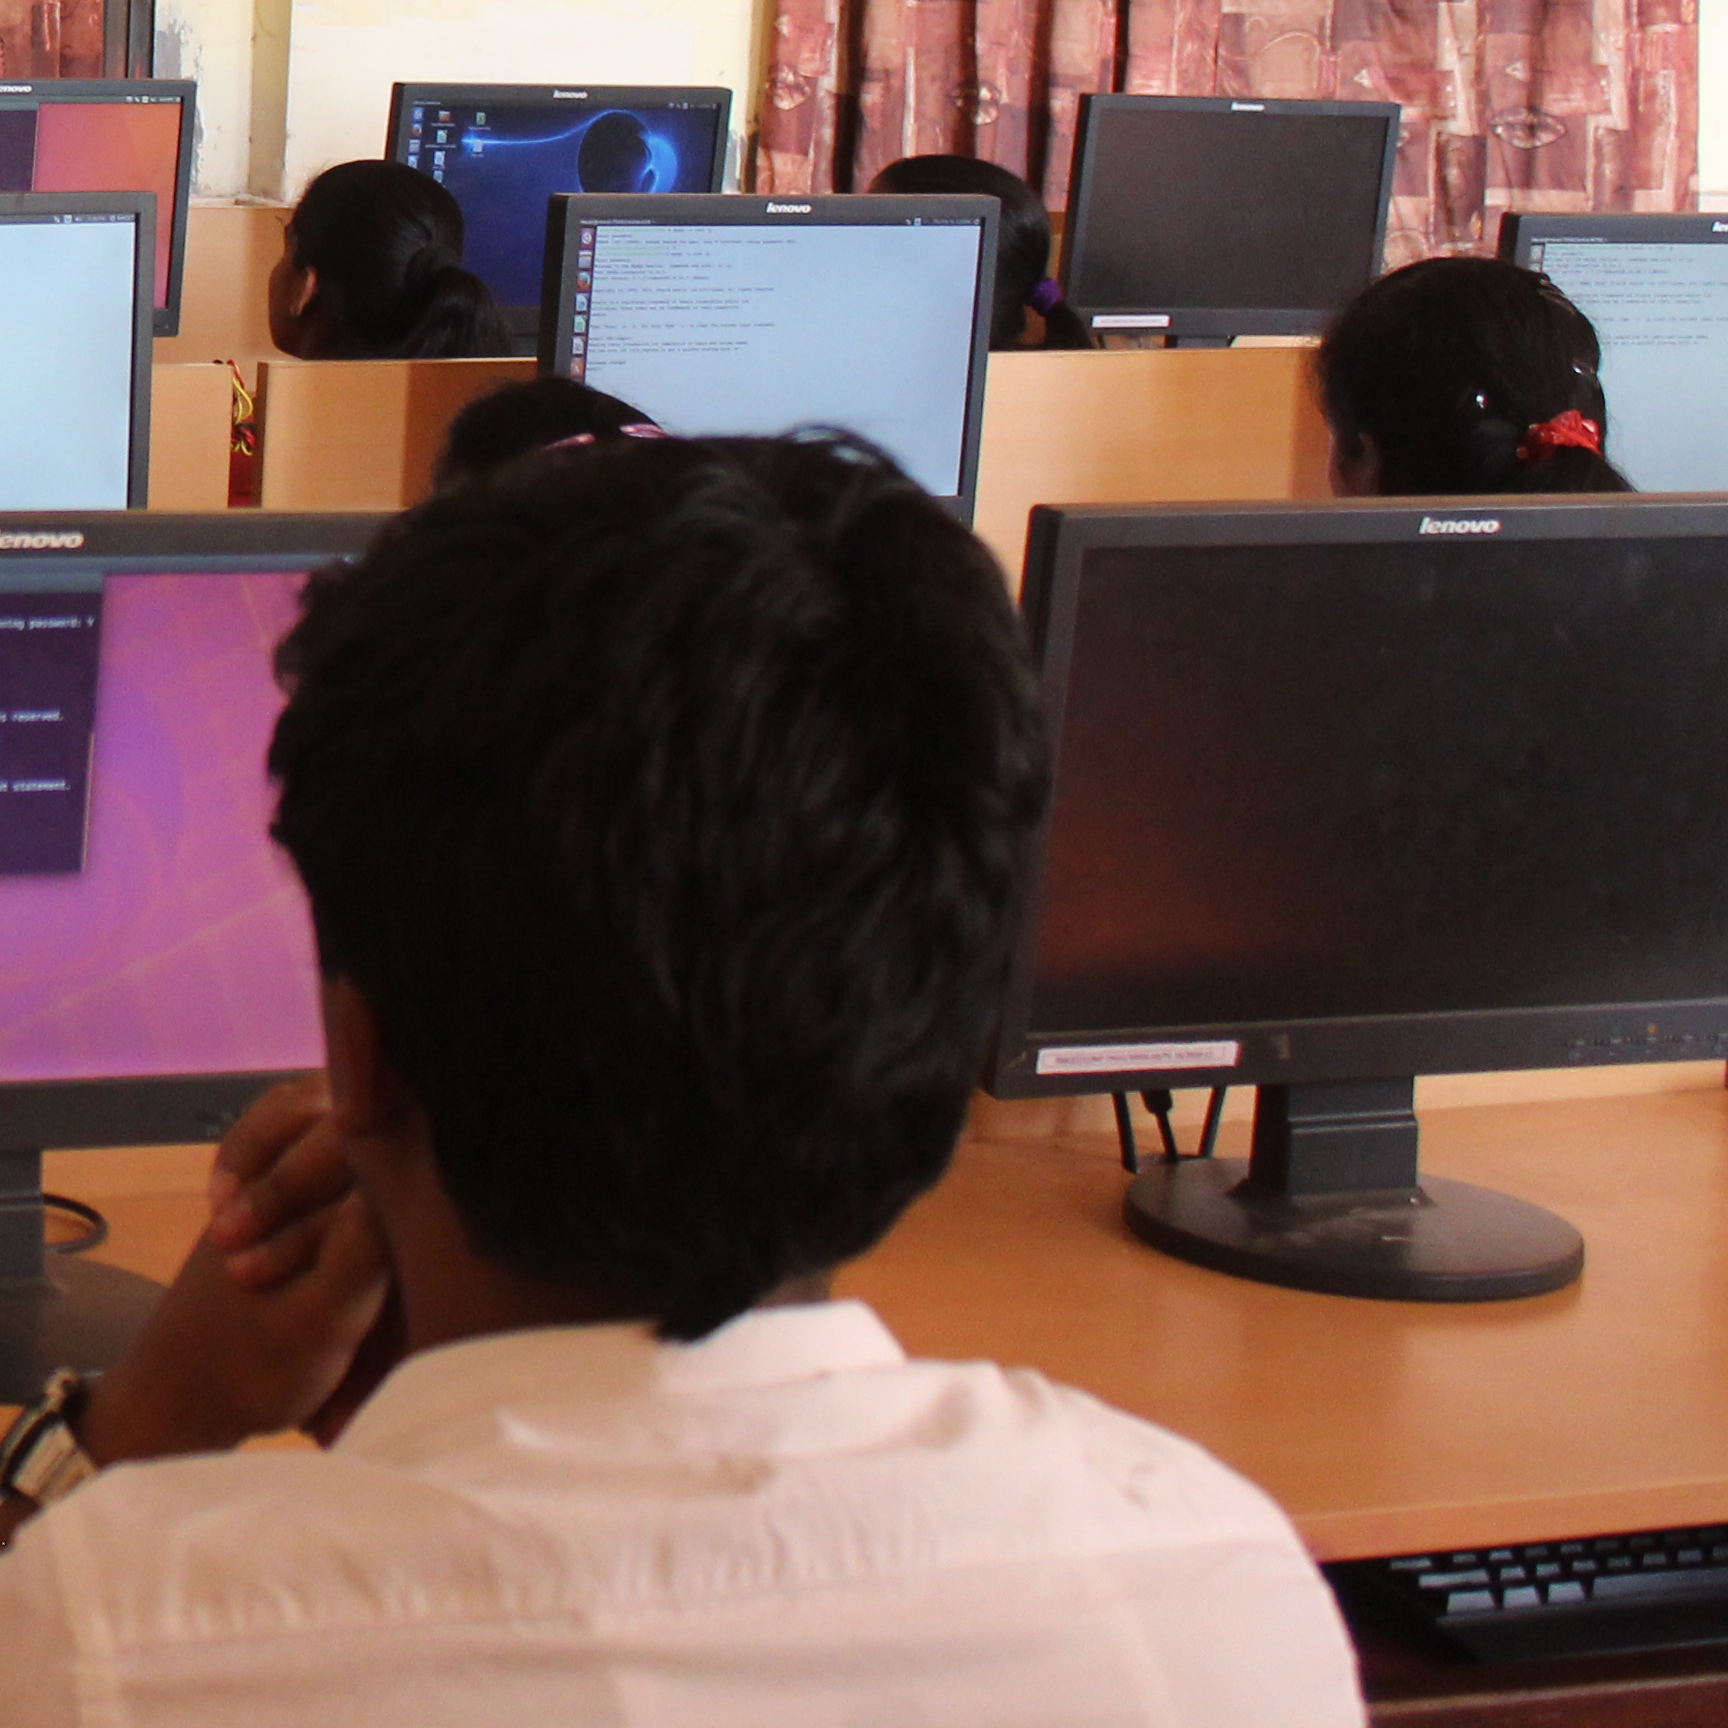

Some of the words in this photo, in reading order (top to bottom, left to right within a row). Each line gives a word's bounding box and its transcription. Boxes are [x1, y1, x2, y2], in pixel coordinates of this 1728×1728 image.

[553, 89, 588, 99] lenovo
[767, 203, 812, 214] lenovo
[1420, 516, 1500, 534] lenovo
